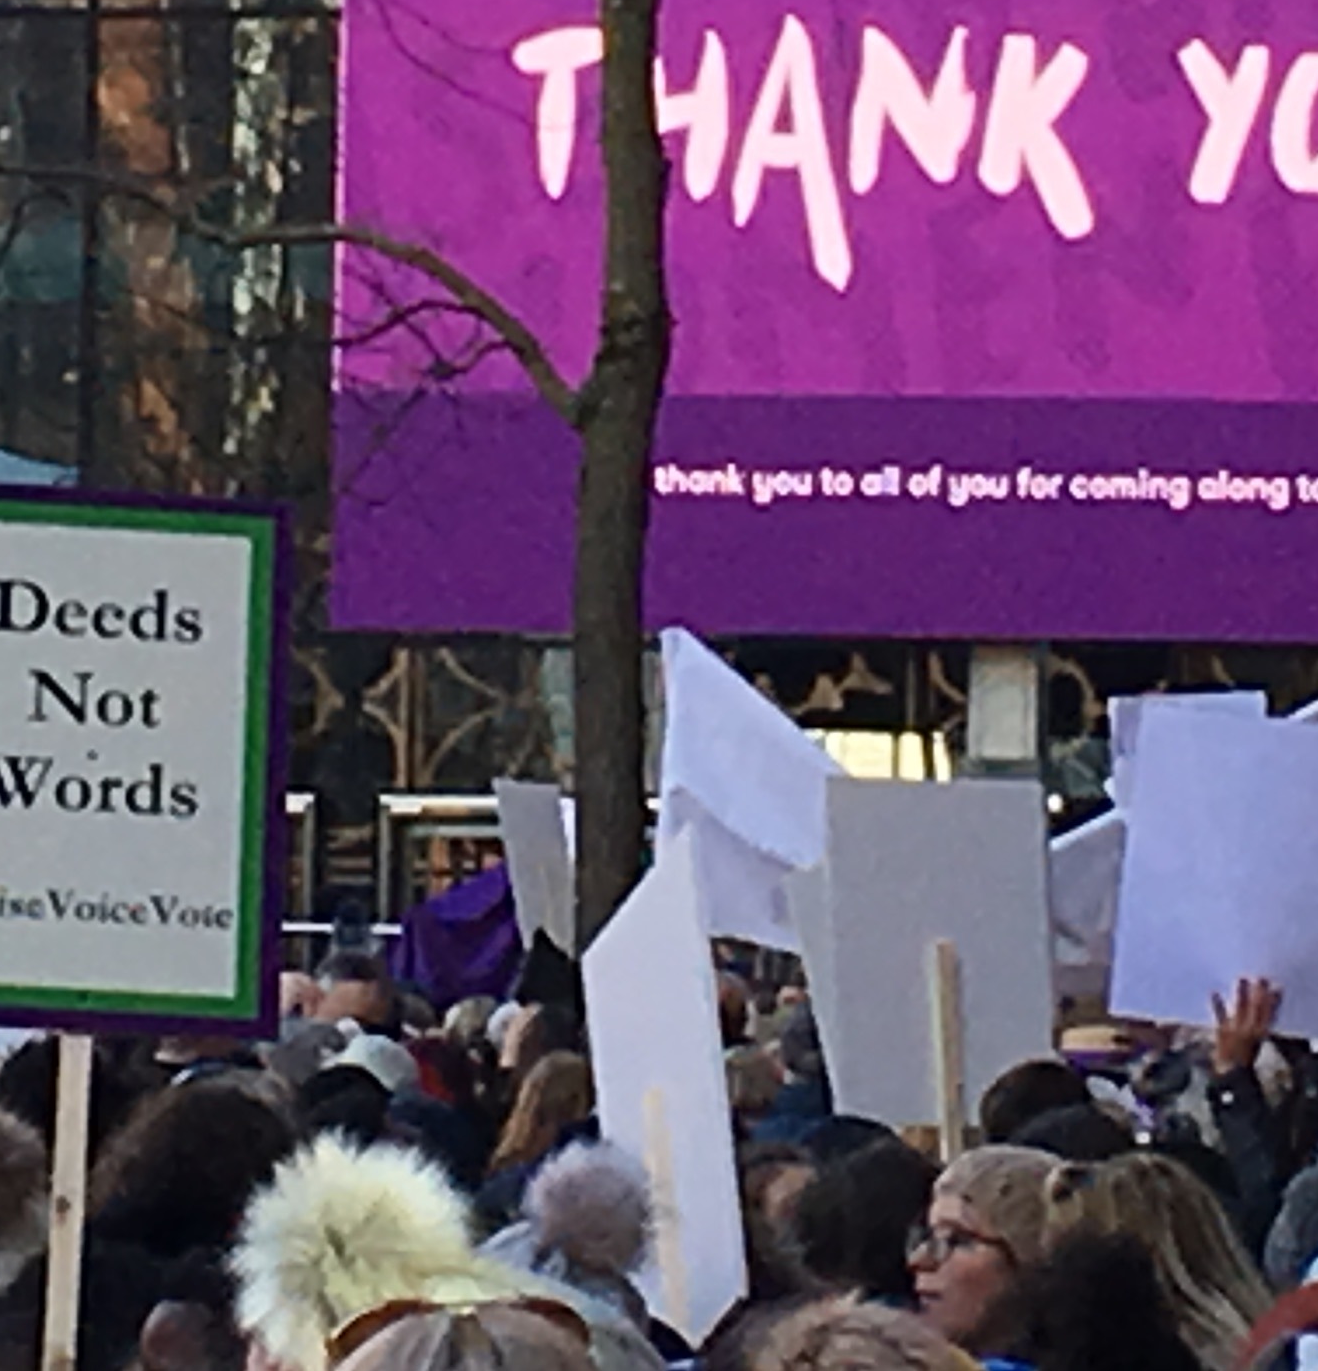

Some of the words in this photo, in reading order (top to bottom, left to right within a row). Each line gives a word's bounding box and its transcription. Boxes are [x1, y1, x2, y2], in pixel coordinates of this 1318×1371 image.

[511, 13, 1094, 291] THANK
[653, 463, 745, 496] thank
[751, 470, 812, 503] you
[818, 466, 854, 496] to
[859, 465, 900, 496] all
[906, 464, 942, 497] of
[947, 473, 1009, 506] you
[1016, 466, 1063, 499] for
[1068, 467, 1191, 509] coming
[1197, 469, 1289, 510] along
[28, 668, 160, 728] Not
